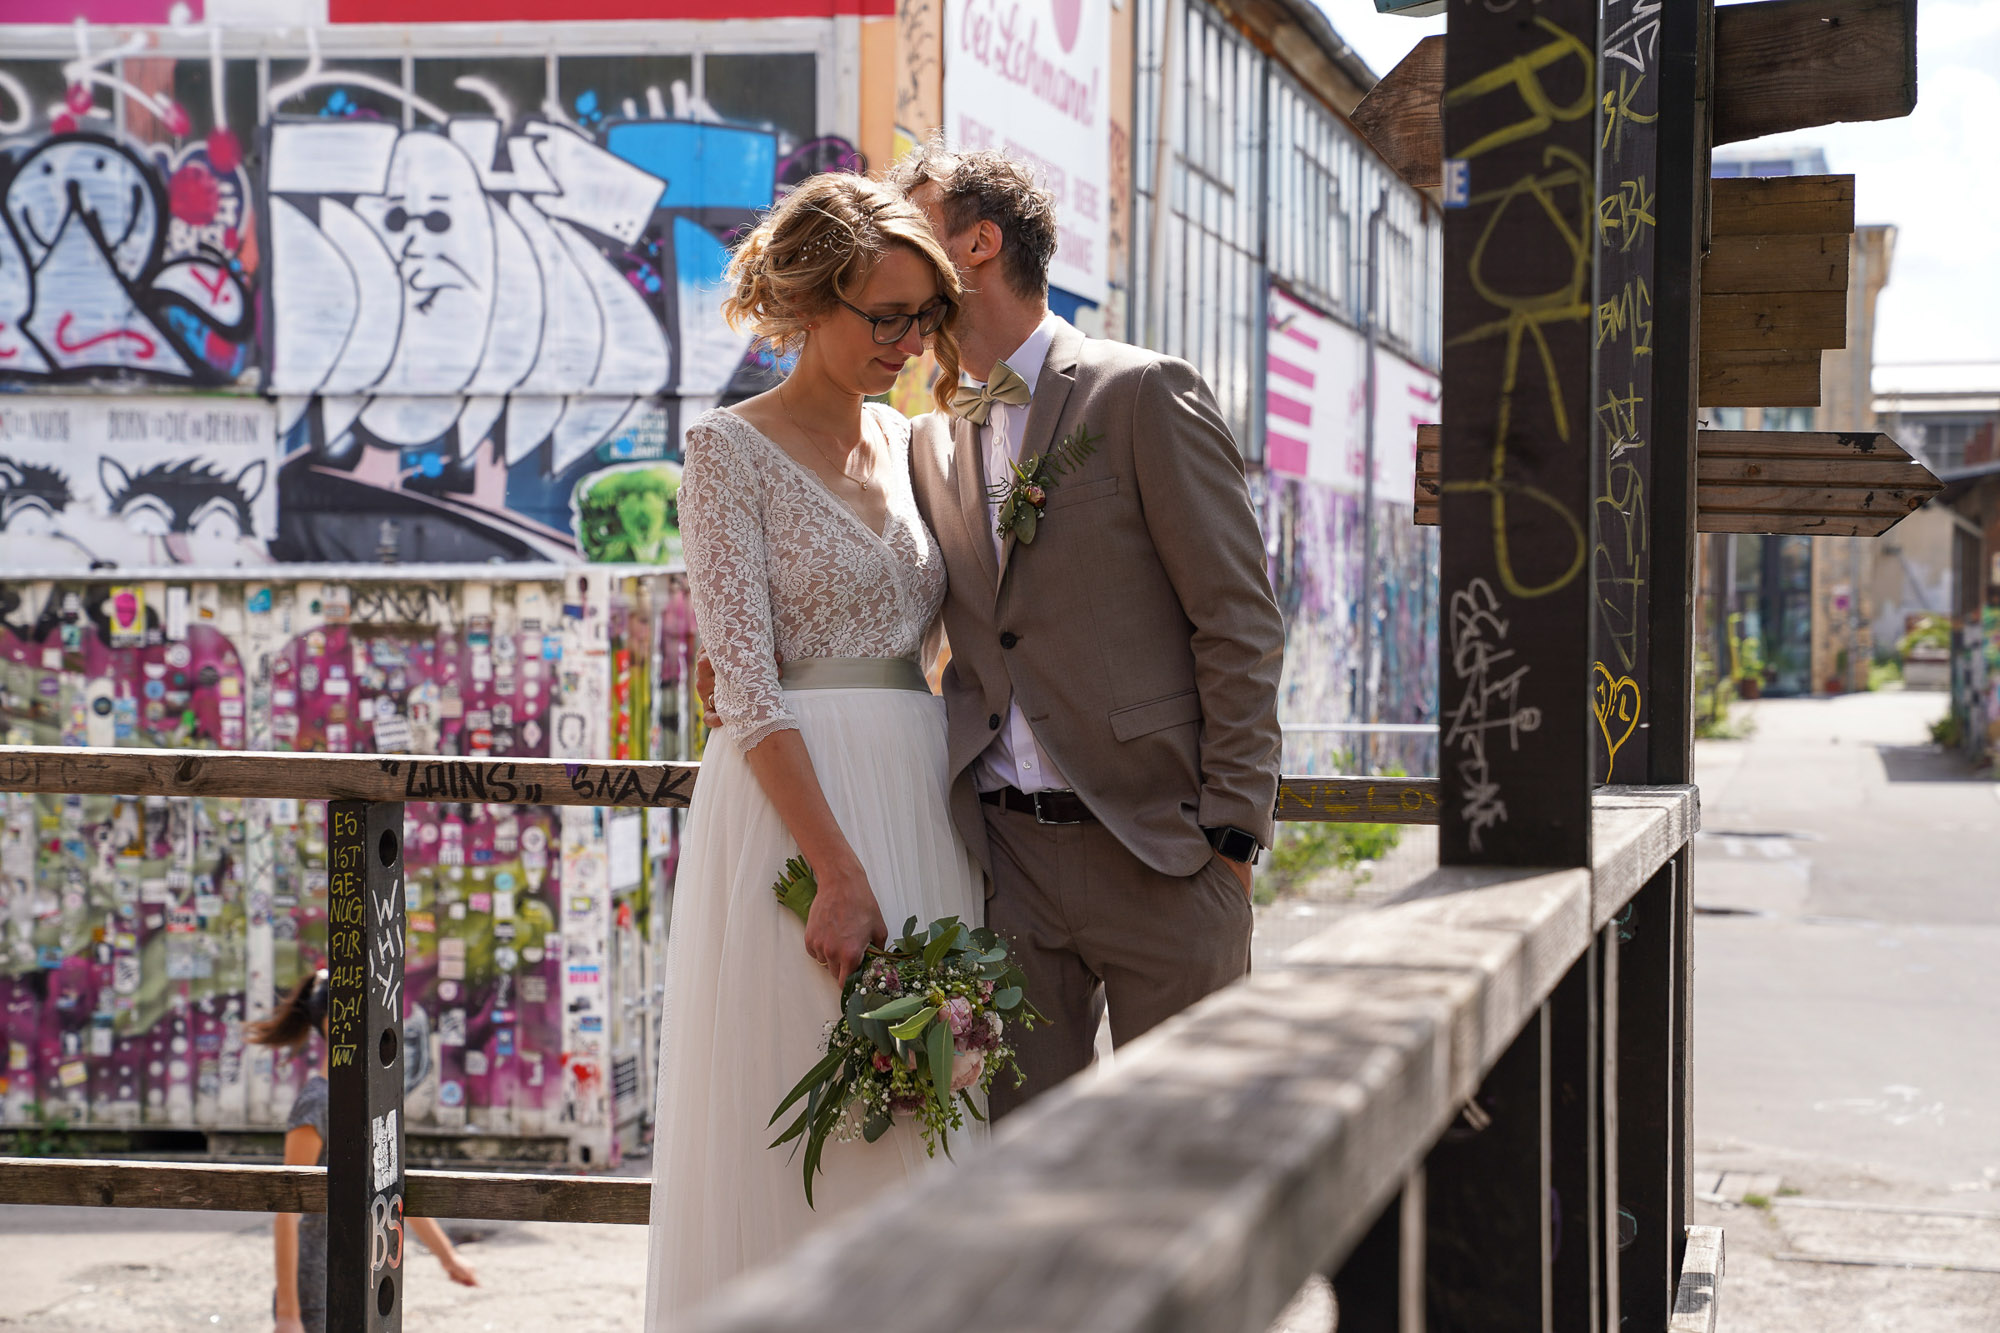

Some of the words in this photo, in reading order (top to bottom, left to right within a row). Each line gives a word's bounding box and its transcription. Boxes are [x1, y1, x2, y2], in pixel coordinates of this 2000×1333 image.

[334, 811, 358, 837] ES
[332, 925, 361, 960] FÜR
[329, 966, 364, 989] ALLE
[332, 994, 363, 1024] DA!
